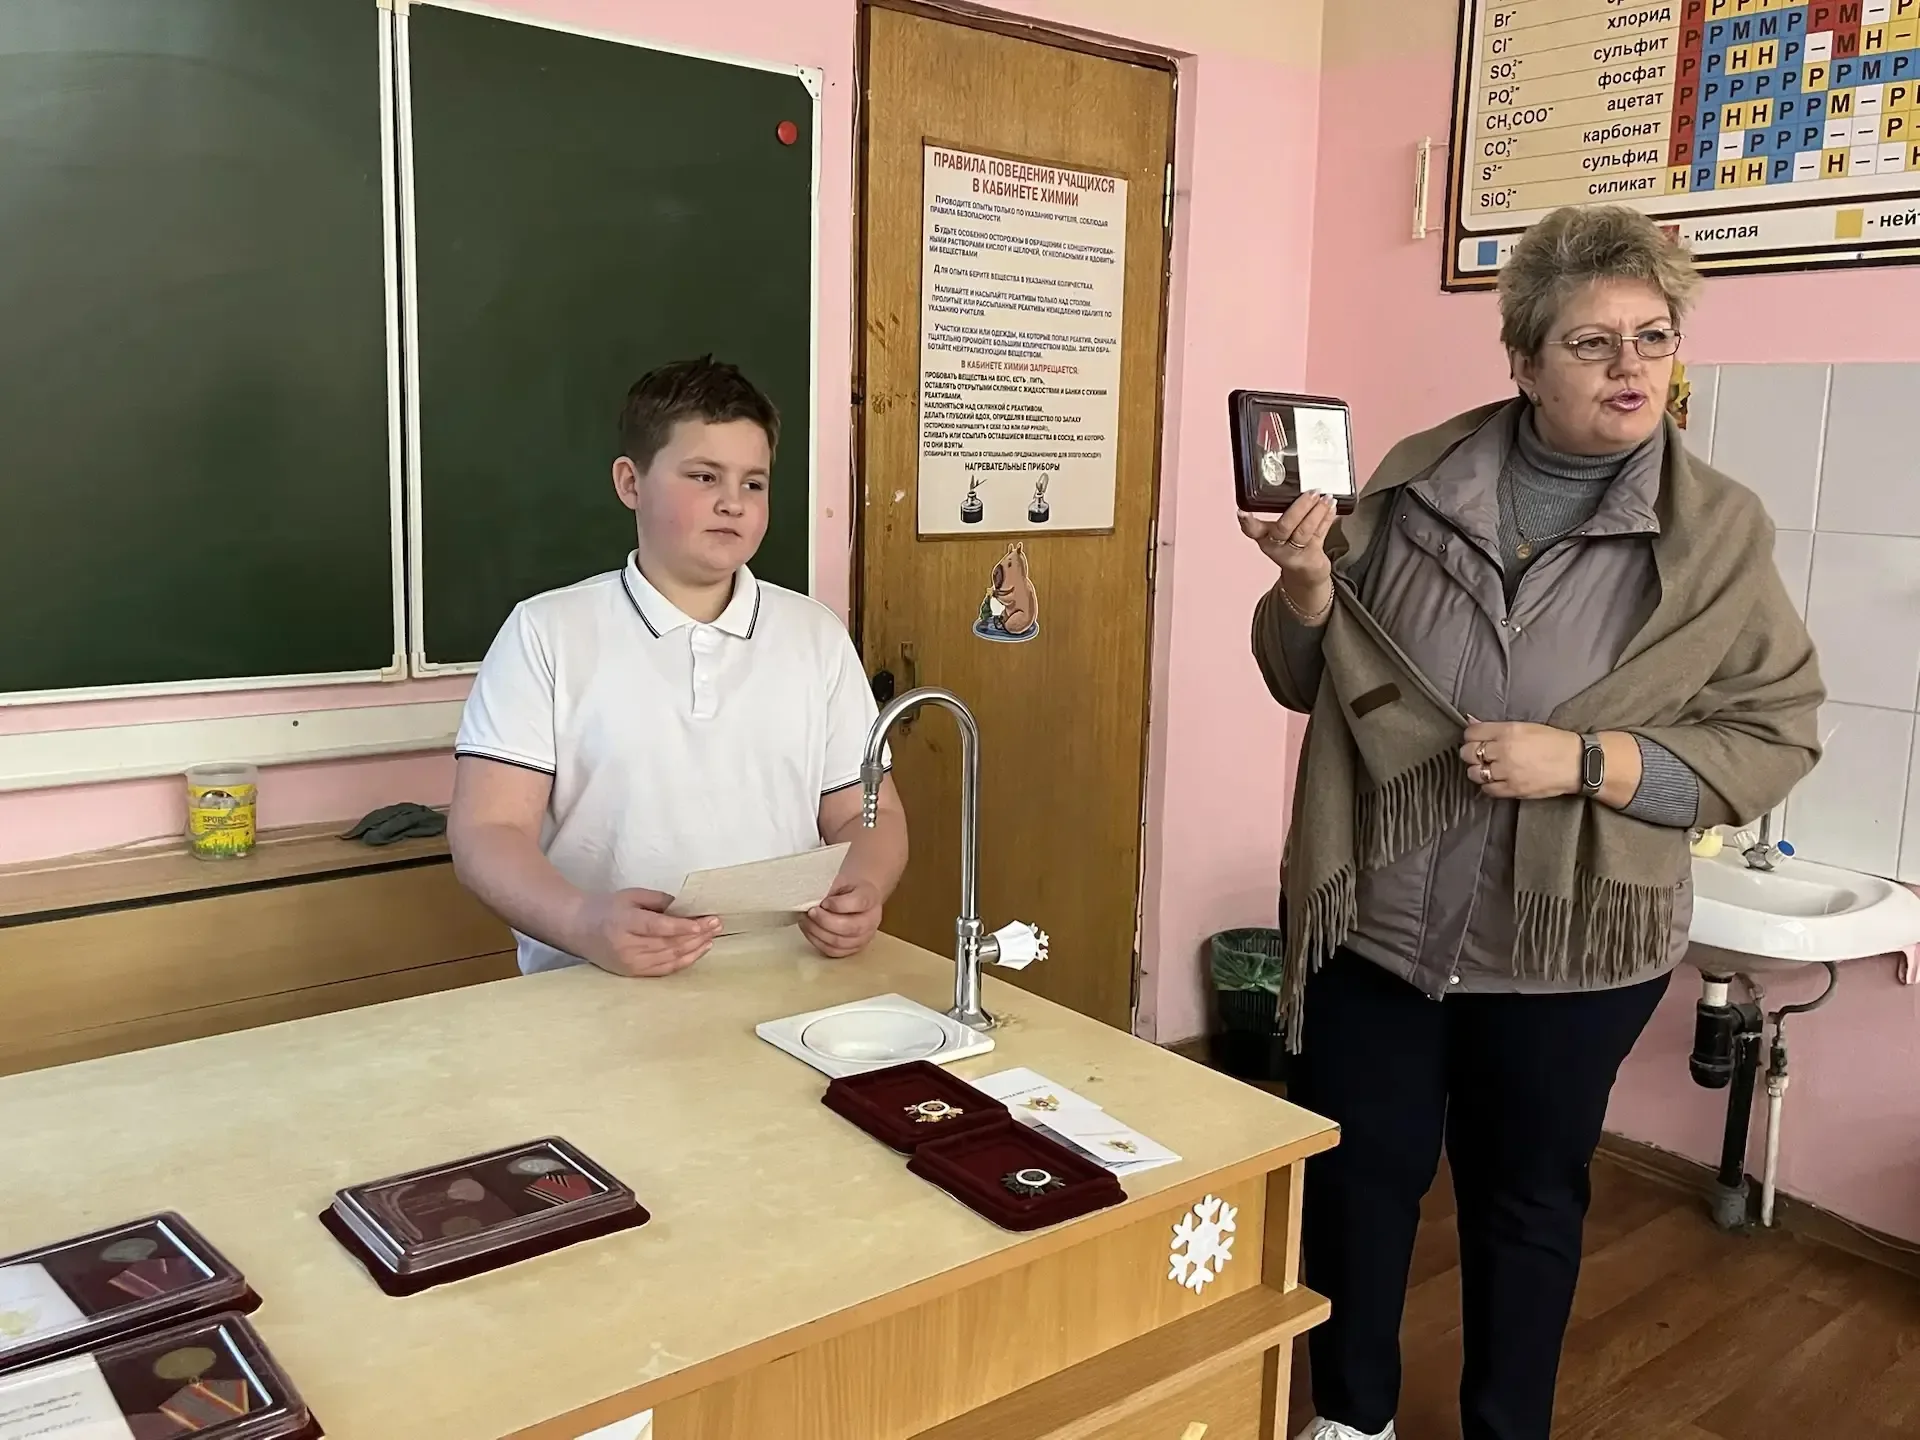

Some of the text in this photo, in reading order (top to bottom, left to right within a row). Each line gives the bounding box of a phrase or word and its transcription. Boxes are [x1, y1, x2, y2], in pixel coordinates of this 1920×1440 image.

[1607, 7, 1671, 30] хлорид
[1593, 37, 1669, 63] сульфит
[1598, 65, 1666, 90] фосфат
[1607, 92, 1664, 112] ацетат
[1583, 121, 1661, 144] карбонат
[1582, 149, 1658, 172] сульфид
[933, 151, 1115, 193] ПРАВИЛА ПОВЕДЕНИЯ УЧАЩИХСЯ
[972, 178, 1079, 207] В КАБИНЕТЕ ХИМИИ
[1588, 176, 1657, 195] силикат
[929, 205, 956, 216] ПРАВИЛА
[993, 205, 1016, 215] ТОЛЬКО
[1024, 210, 1054, 221] УКАЗАНИЮ
[957, 228, 989, 239] ОСОБЕННО
[989, 233, 1024, 244] ОСТОРОЖНЫ
[1694, 225, 1759, 242] кислая
[929, 236, 947, 244] НЫМИ
[947, 238, 985, 249] РАСТВОРАМИ
[985, 243, 1007, 252] КИСЛОТ
[948, 267, 968, 276] ОПЫТА
[969, 270, 990, 280] БЕРИТЕ
[990, 273, 1020, 282] ВЕЩЕСТВА
[931, 294, 962, 304] ПРОЛИТЫЕ
[975, 299, 1017, 310] РАССЫПАННЫЕ
[1017, 303, 1046, 312] РЕАКТИВЫ
[975, 290, 1008, 300] НАСЫПАЙТЕ
[1008, 293, 1037, 302] РЕАКТИВЫ
[1037, 296, 1058, 304] ТОЛЬКО
[928, 304, 959, 314] УКАЗАНИЮ
[927, 333, 961, 343] ТЩАТЕЛЬНО
[962, 336, 992, 345] ПРОМОЙТЕ
[993, 339, 1022, 348] БОЛЬШИМ
[1022, 341, 1061, 350] КОЛИЧЕСТВОМ
[961, 326, 978, 335] КОЖИ
[1026, 333, 1051, 341] КОТОРЫЕ
[927, 343, 1007, 356] БОТАЙТЕ НЕЙТРАЛИЗУЮЩИМ
[961, 360, 966, 369] В
[966, 361, 1002, 370] КАБИНЕТЕ
[1003, 362, 1029, 372] ХИМИИ
[924, 371, 957, 380] ПРОБОВАТЬ
[958, 373, 988, 382] ВЕЩЕСТВА
[924, 381, 957, 390] ОСТАВЛЯТЬ
[957, 383, 992, 391] ОТКРЫТЫМИ
[992, 384, 1018, 392] СКЛЯНКИ
[1023, 386, 1060, 395] ЖИДКОСТЯМИ
[924, 402, 964, 410] НАКЛОНЯТЬСЯ
[964, 403, 976, 411] НАД
[976, 402, 1006, 411] СКЛЯНКОЙ
[924, 411, 945, 420] ДЕЛАТЬ
[945, 411, 975, 420] ГЛУБОКИЙ
[1025, 414, 1055, 422] ВЕЩЕСТВО
[923, 431, 949, 439] СЛИВАТЬ
[961, 432, 987, 440] ССЫПАТЬ
[964, 462, 1061, 471] НАГРЕВАТЕЛЬНЫЕ ПРИБОРЫ
